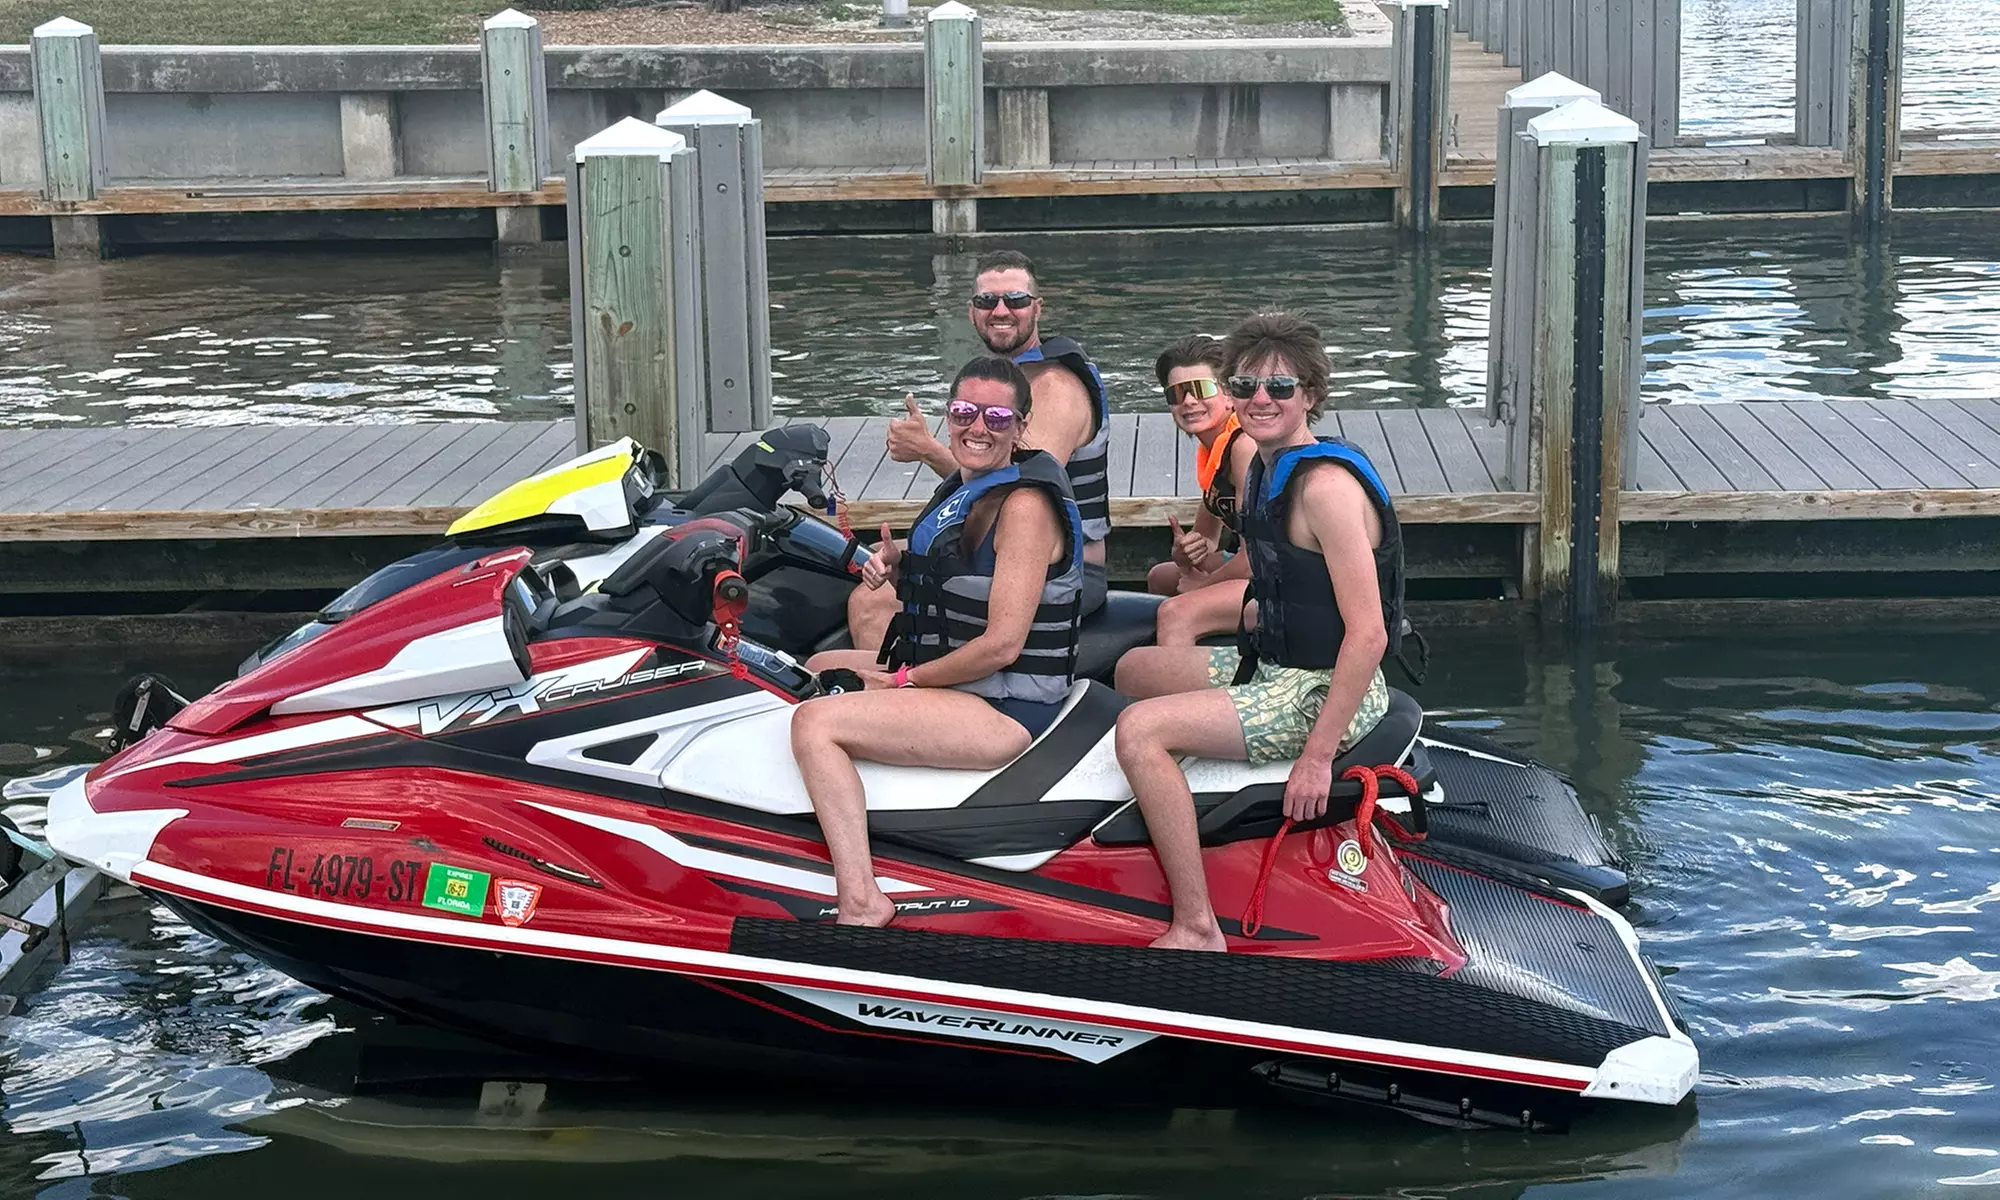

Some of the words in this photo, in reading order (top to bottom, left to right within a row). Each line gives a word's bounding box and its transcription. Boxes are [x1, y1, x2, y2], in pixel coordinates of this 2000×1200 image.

[418, 674, 568, 736] VX
[545, 660, 706, 702] CRUISER
[437, 896, 471, 910] FLORIDA
[895, 901, 946, 911] TPUT
